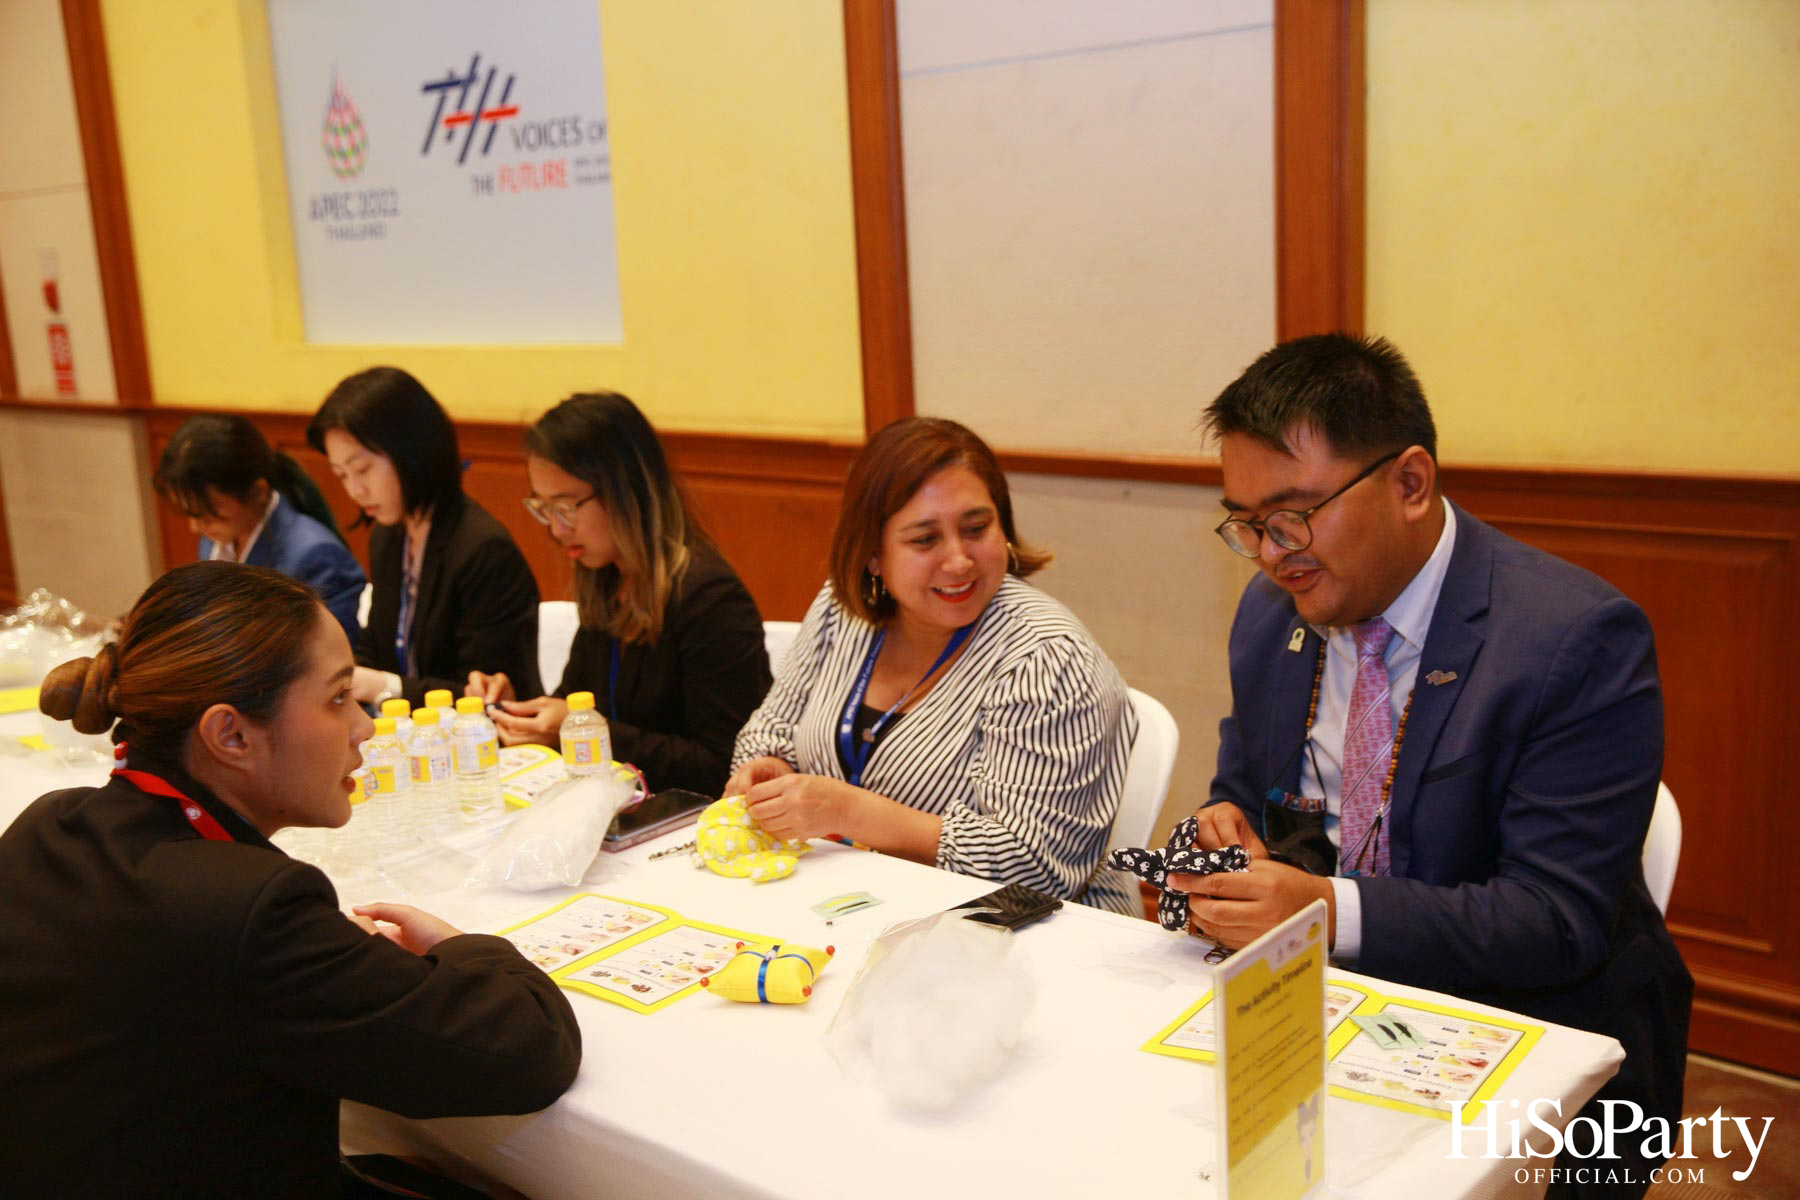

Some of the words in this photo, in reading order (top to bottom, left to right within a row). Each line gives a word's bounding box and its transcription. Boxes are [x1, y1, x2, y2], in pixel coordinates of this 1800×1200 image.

[509, 115, 584, 152] VOICES
[471, 173, 495, 196] THE
[499, 159, 567, 192] FUTURE
